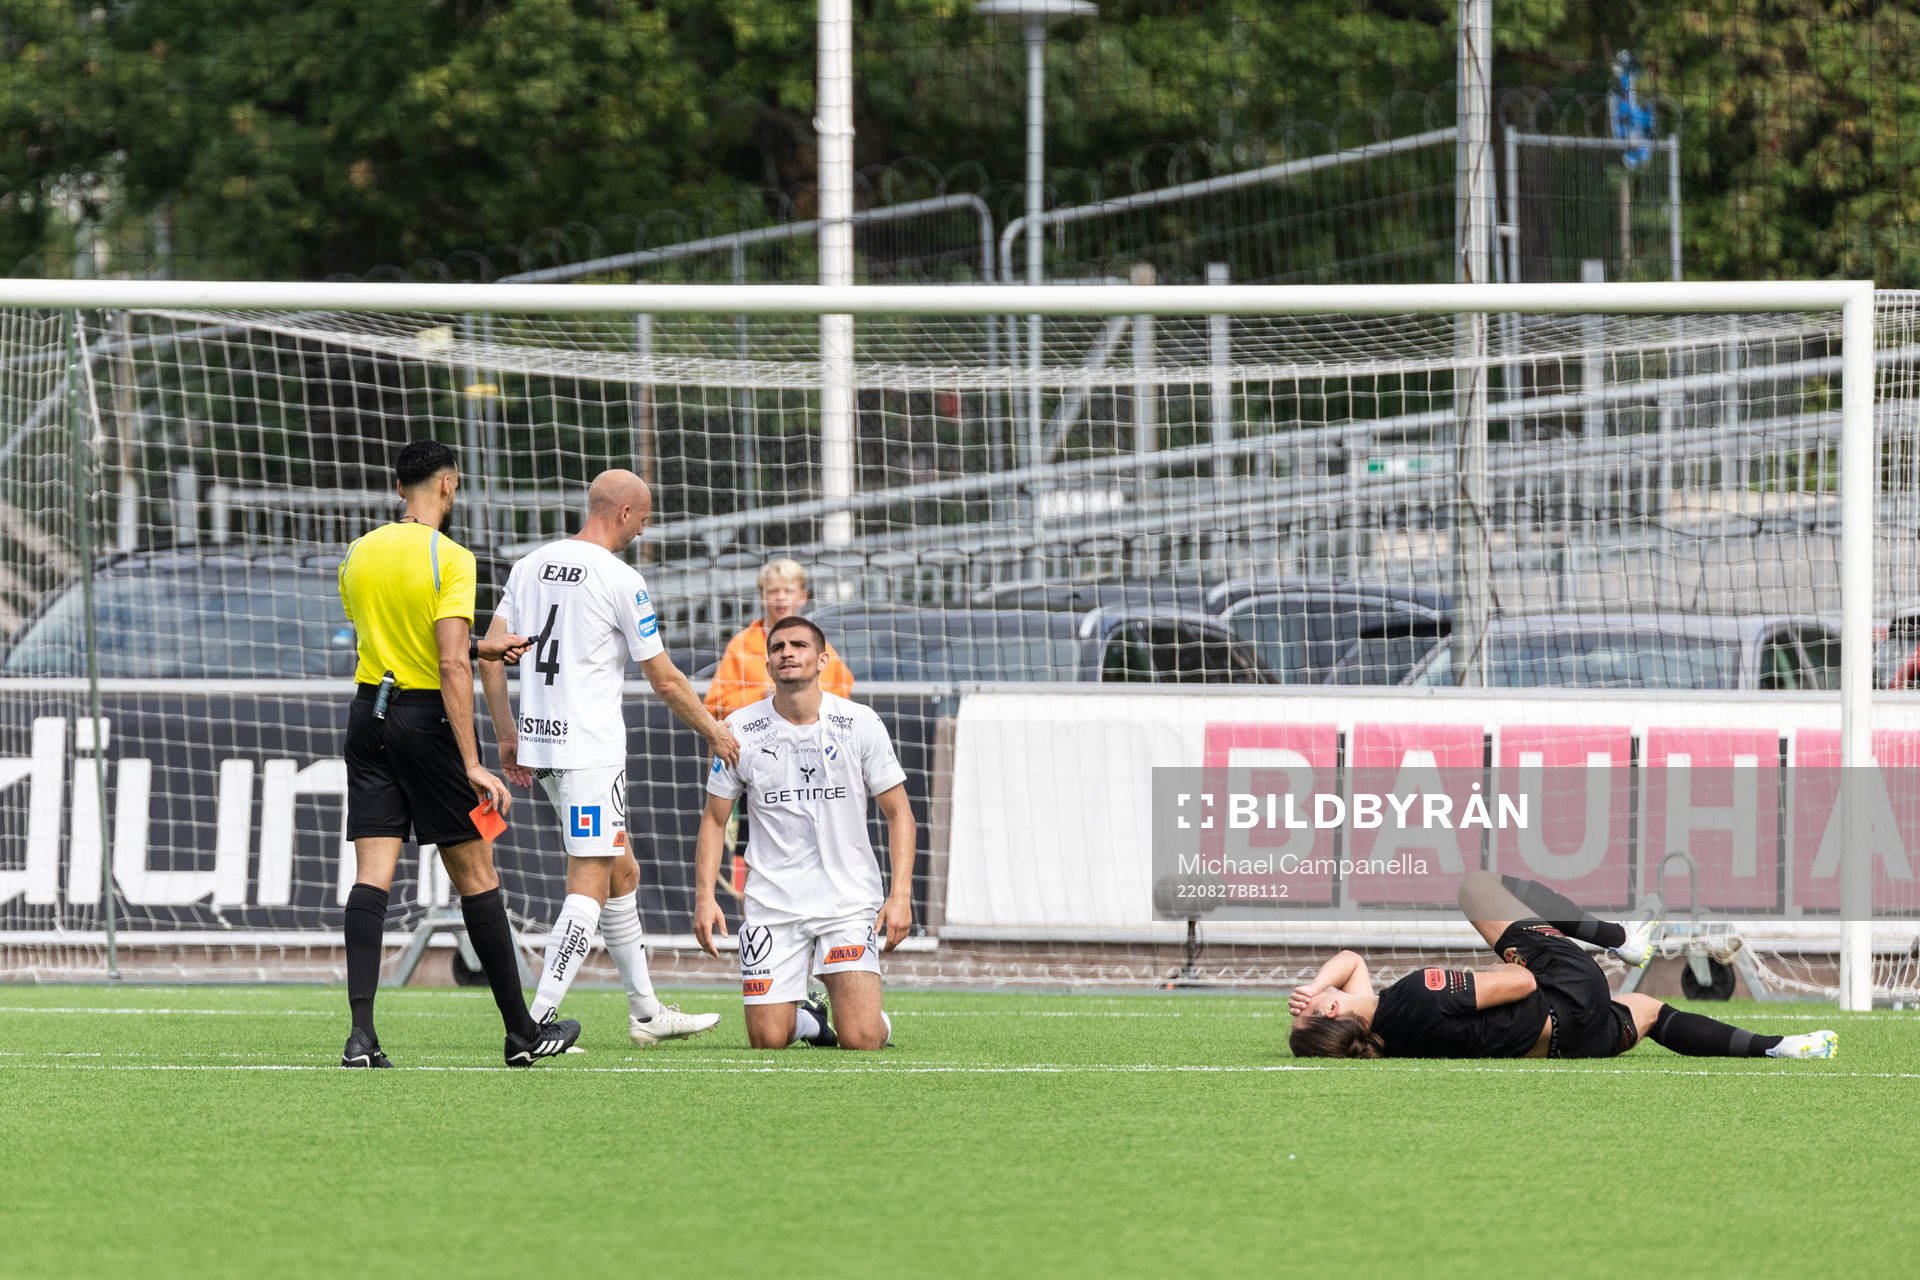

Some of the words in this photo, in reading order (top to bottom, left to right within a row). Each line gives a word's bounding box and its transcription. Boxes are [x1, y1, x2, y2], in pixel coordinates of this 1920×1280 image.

[542, 564, 583, 583] EAB
[535, 604, 560, 686] 4
[743, 716, 770, 733] sport
[827, 714, 854, 725] sport
[764, 786, 847, 804] GETINGE
[553, 924, 585, 982] Transport
[576, 936, 589, 958] GN
[830, 947, 859, 960] JONAB
